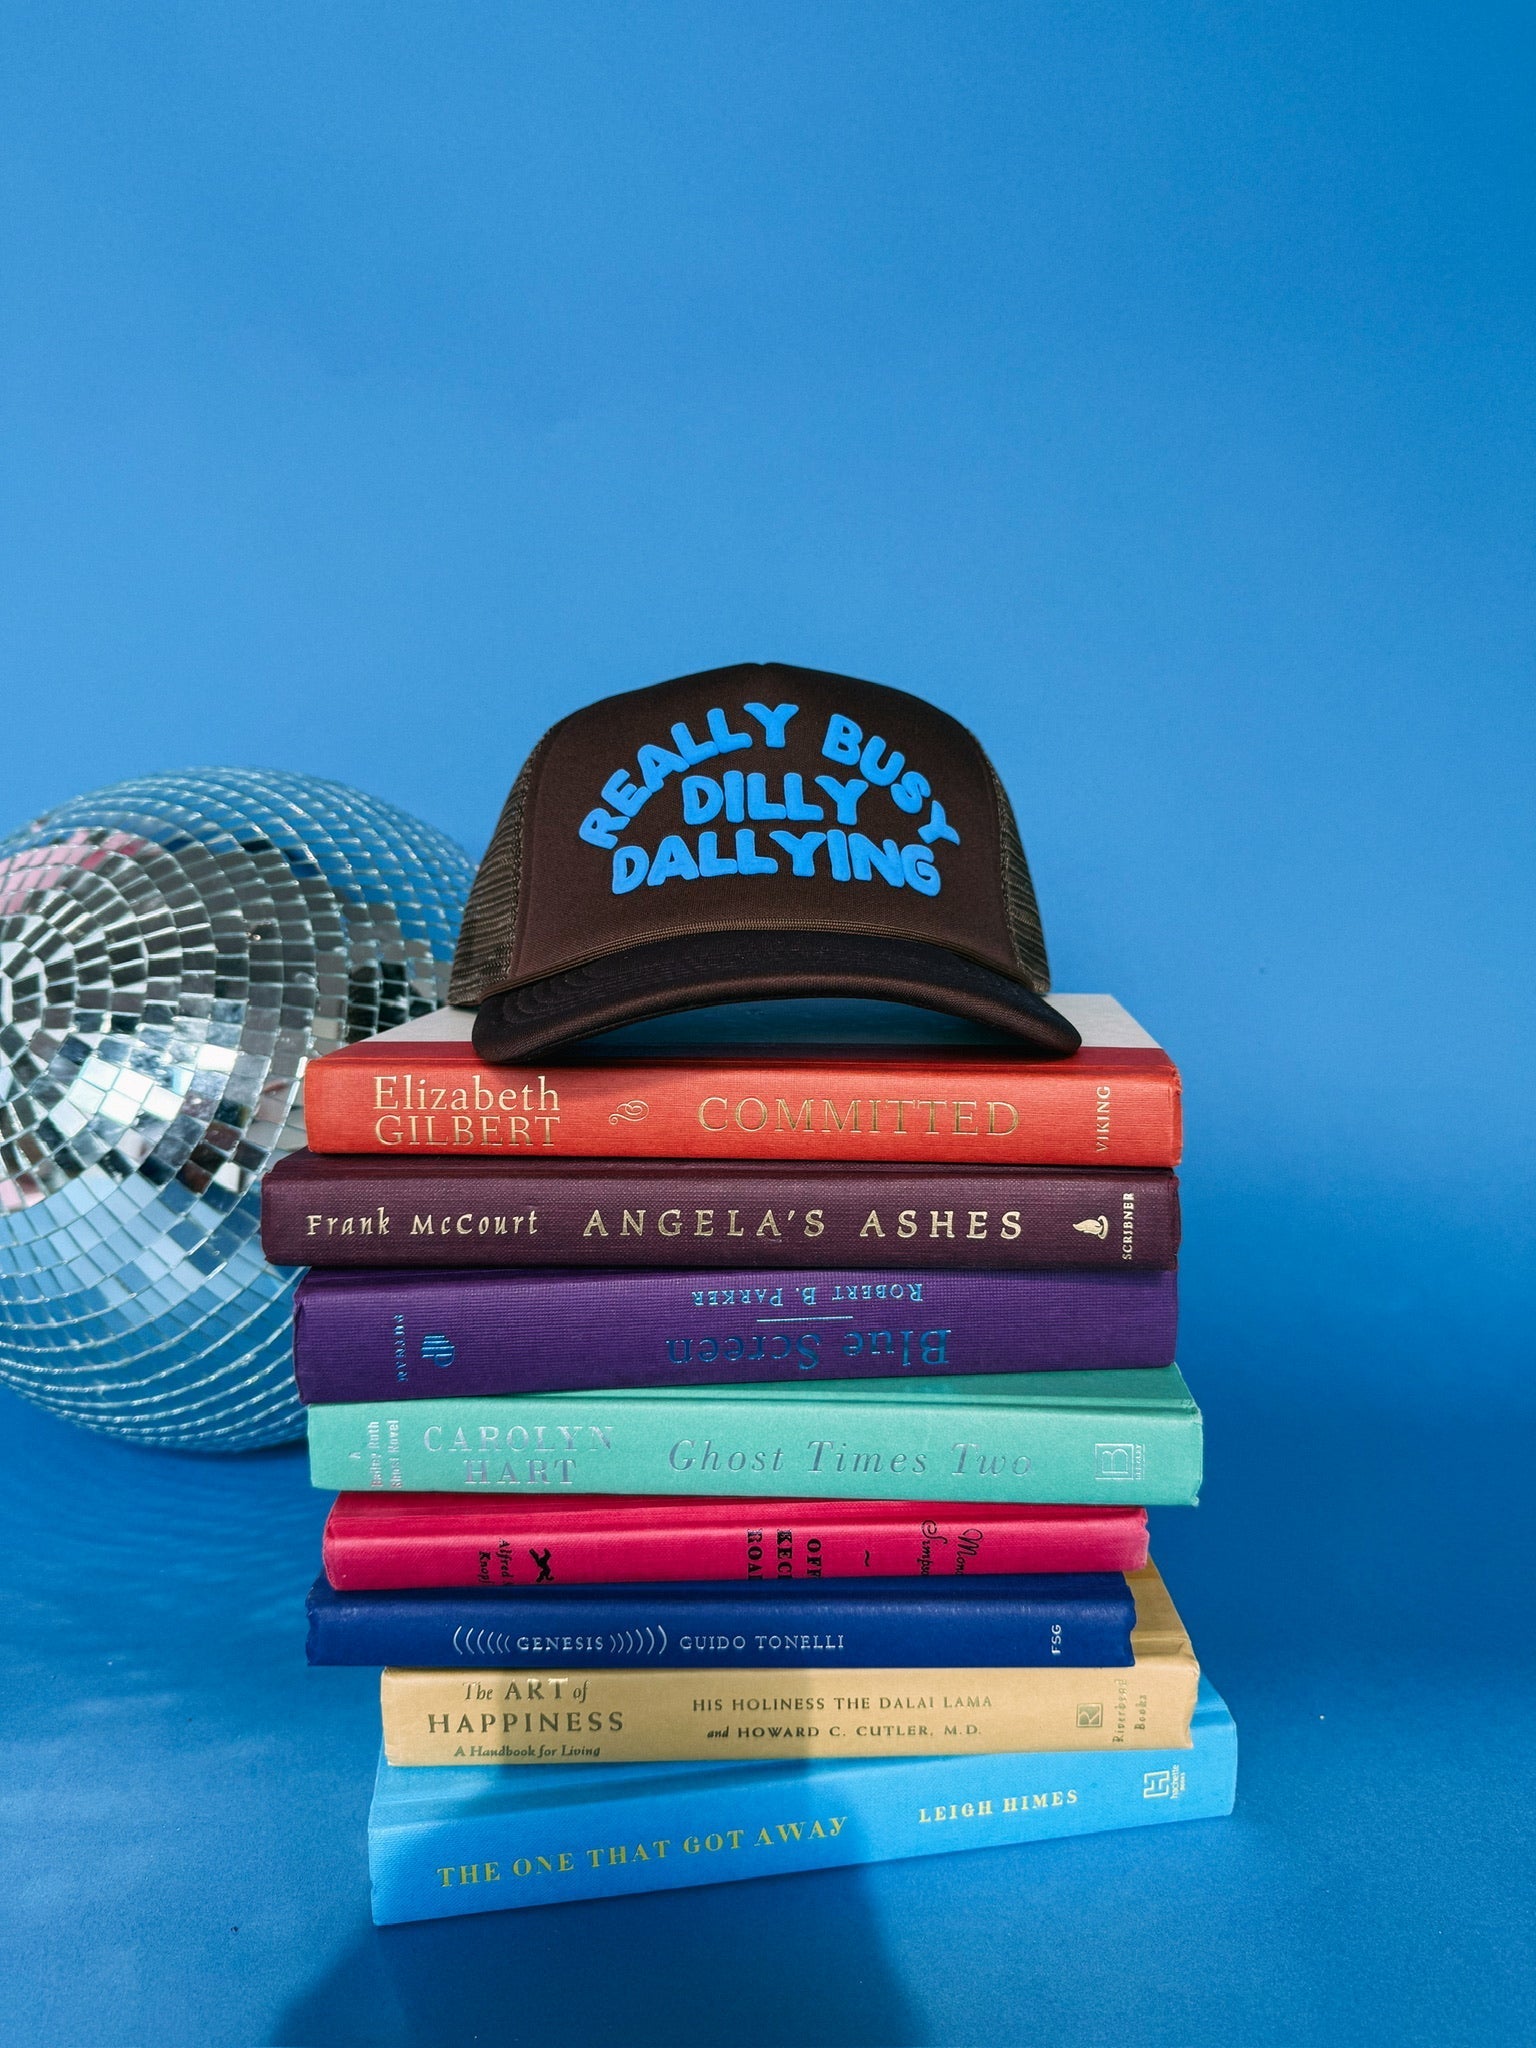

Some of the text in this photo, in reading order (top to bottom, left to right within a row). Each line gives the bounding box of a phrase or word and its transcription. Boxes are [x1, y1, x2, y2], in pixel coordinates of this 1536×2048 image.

[578, 702, 960, 850] REALLY BUSY
[682, 770, 869, 826] DILLY
[612, 828, 941, 896] DALLYING
[373, 1075, 560, 1111] Elizabeth
[375, 1115, 560, 1146] GILBERT
[698, 1096, 1020, 1136] COMMITTED
[1096, 1085, 1111, 1152] VIKING
[306, 1207, 538, 1235] Frank McCourt
[583, 1209, 1022, 1239] ANGELA'S ASHES
[1122, 1191, 1135, 1260] SCRIBNER
[795, 1286, 817, 1305] B.
[667, 1328, 952, 1371] Blue Screen
[423, 1424, 614, 1452] CAROLYN
[464, 1459, 577, 1484] HART
[668, 1438, 1032, 1477] Ghost Times Two
[496, 1538, 514, 1578] Alfred
[516, 1634, 845, 1651] GENESIS GUIDO TONELLI
[1051, 1624, 1063, 1654] FSG
[462, 1677, 592, 1704] The ART of
[692, 1696, 993, 1712] HIS HOLINESS THE DALAI LAMA
[428, 1711, 624, 1733] HAPPINESS
[1134, 1695, 1147, 1730] Books
[707, 1724, 981, 1738] and HOWARD C. CUTLER, M.D.
[454, 1744, 601, 1758] A Handbook for Living
[918, 1789, 1079, 1824] LEIGH HIMES
[437, 1860, 501, 1888] THE
[513, 1852, 575, 1877] ONE
[586, 1839, 671, 1869] THAT
[683, 1830, 746, 1854] GOT
